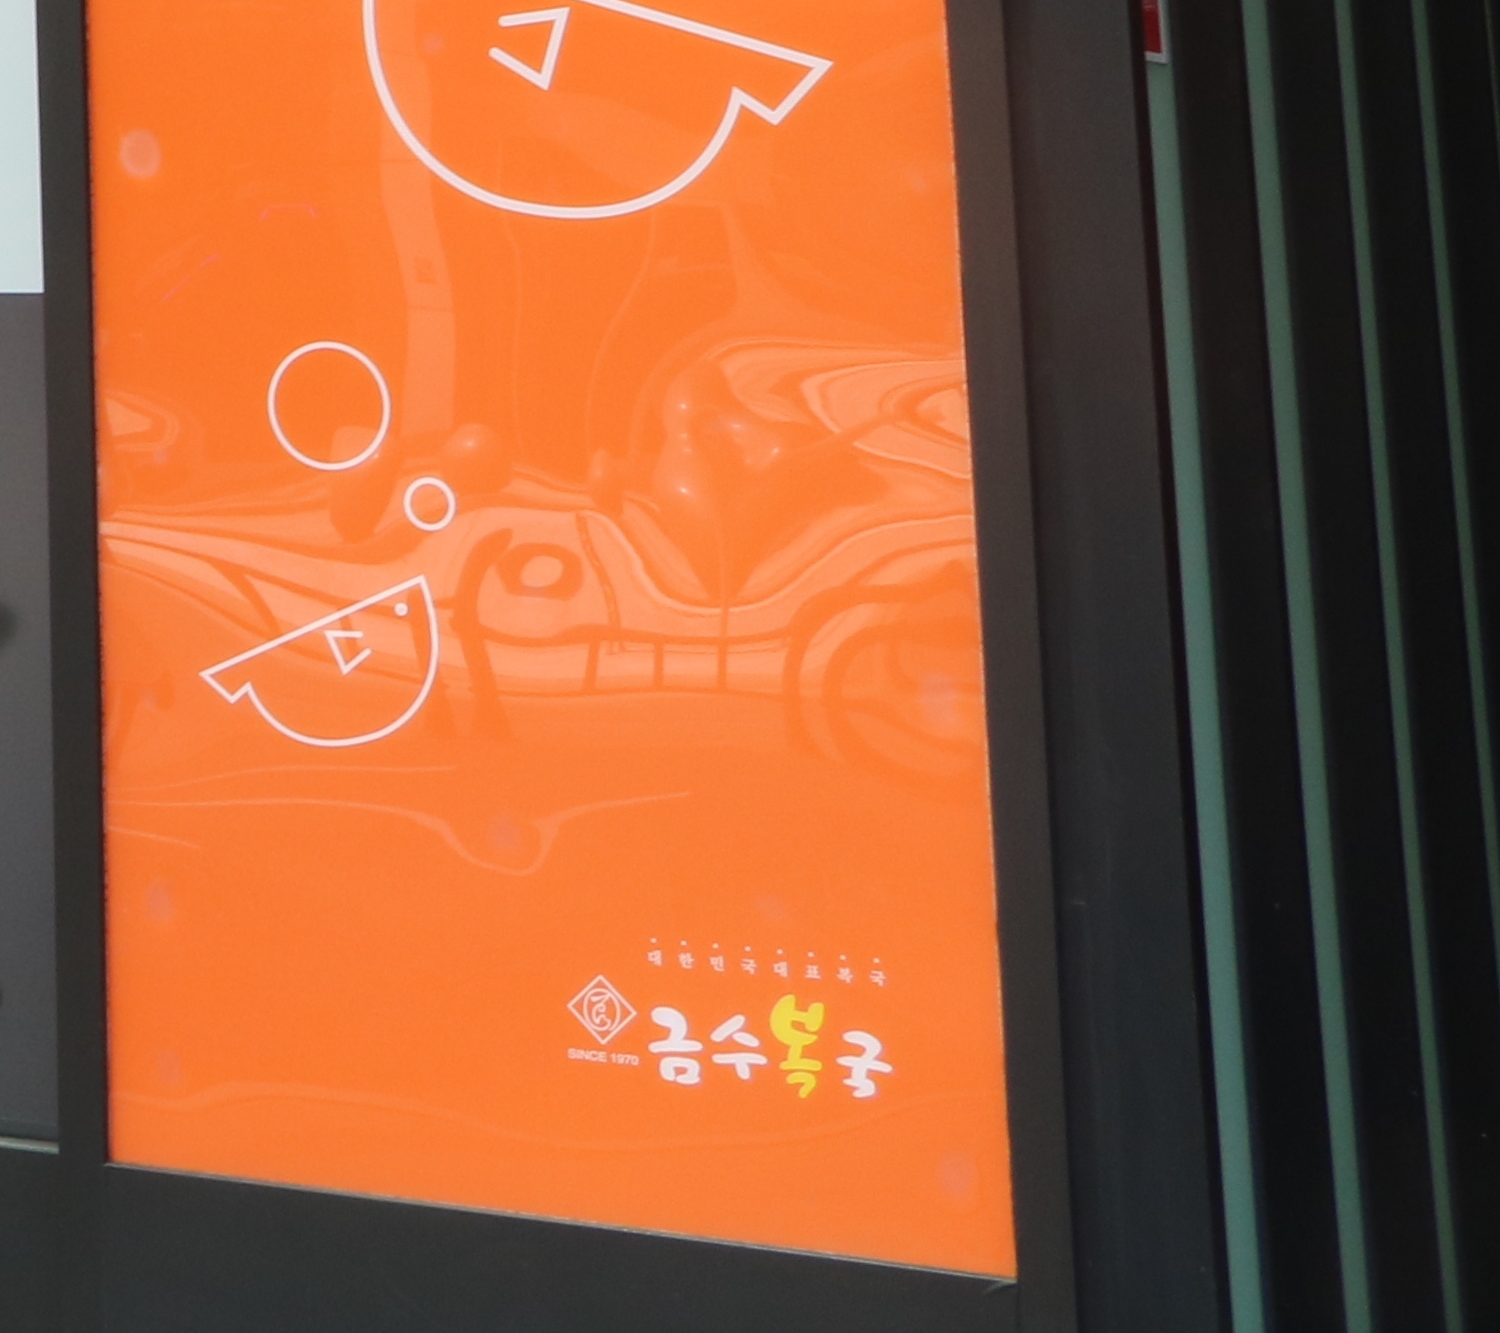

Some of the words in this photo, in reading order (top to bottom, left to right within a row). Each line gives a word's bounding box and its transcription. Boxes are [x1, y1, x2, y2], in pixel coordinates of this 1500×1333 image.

[647, 949, 887, 987] 대한민국대표복국
[566, 1047, 607, 1064] SINCE
[610, 1050, 640, 1067] 1970
[648, 994, 893, 1099] 금수복국
